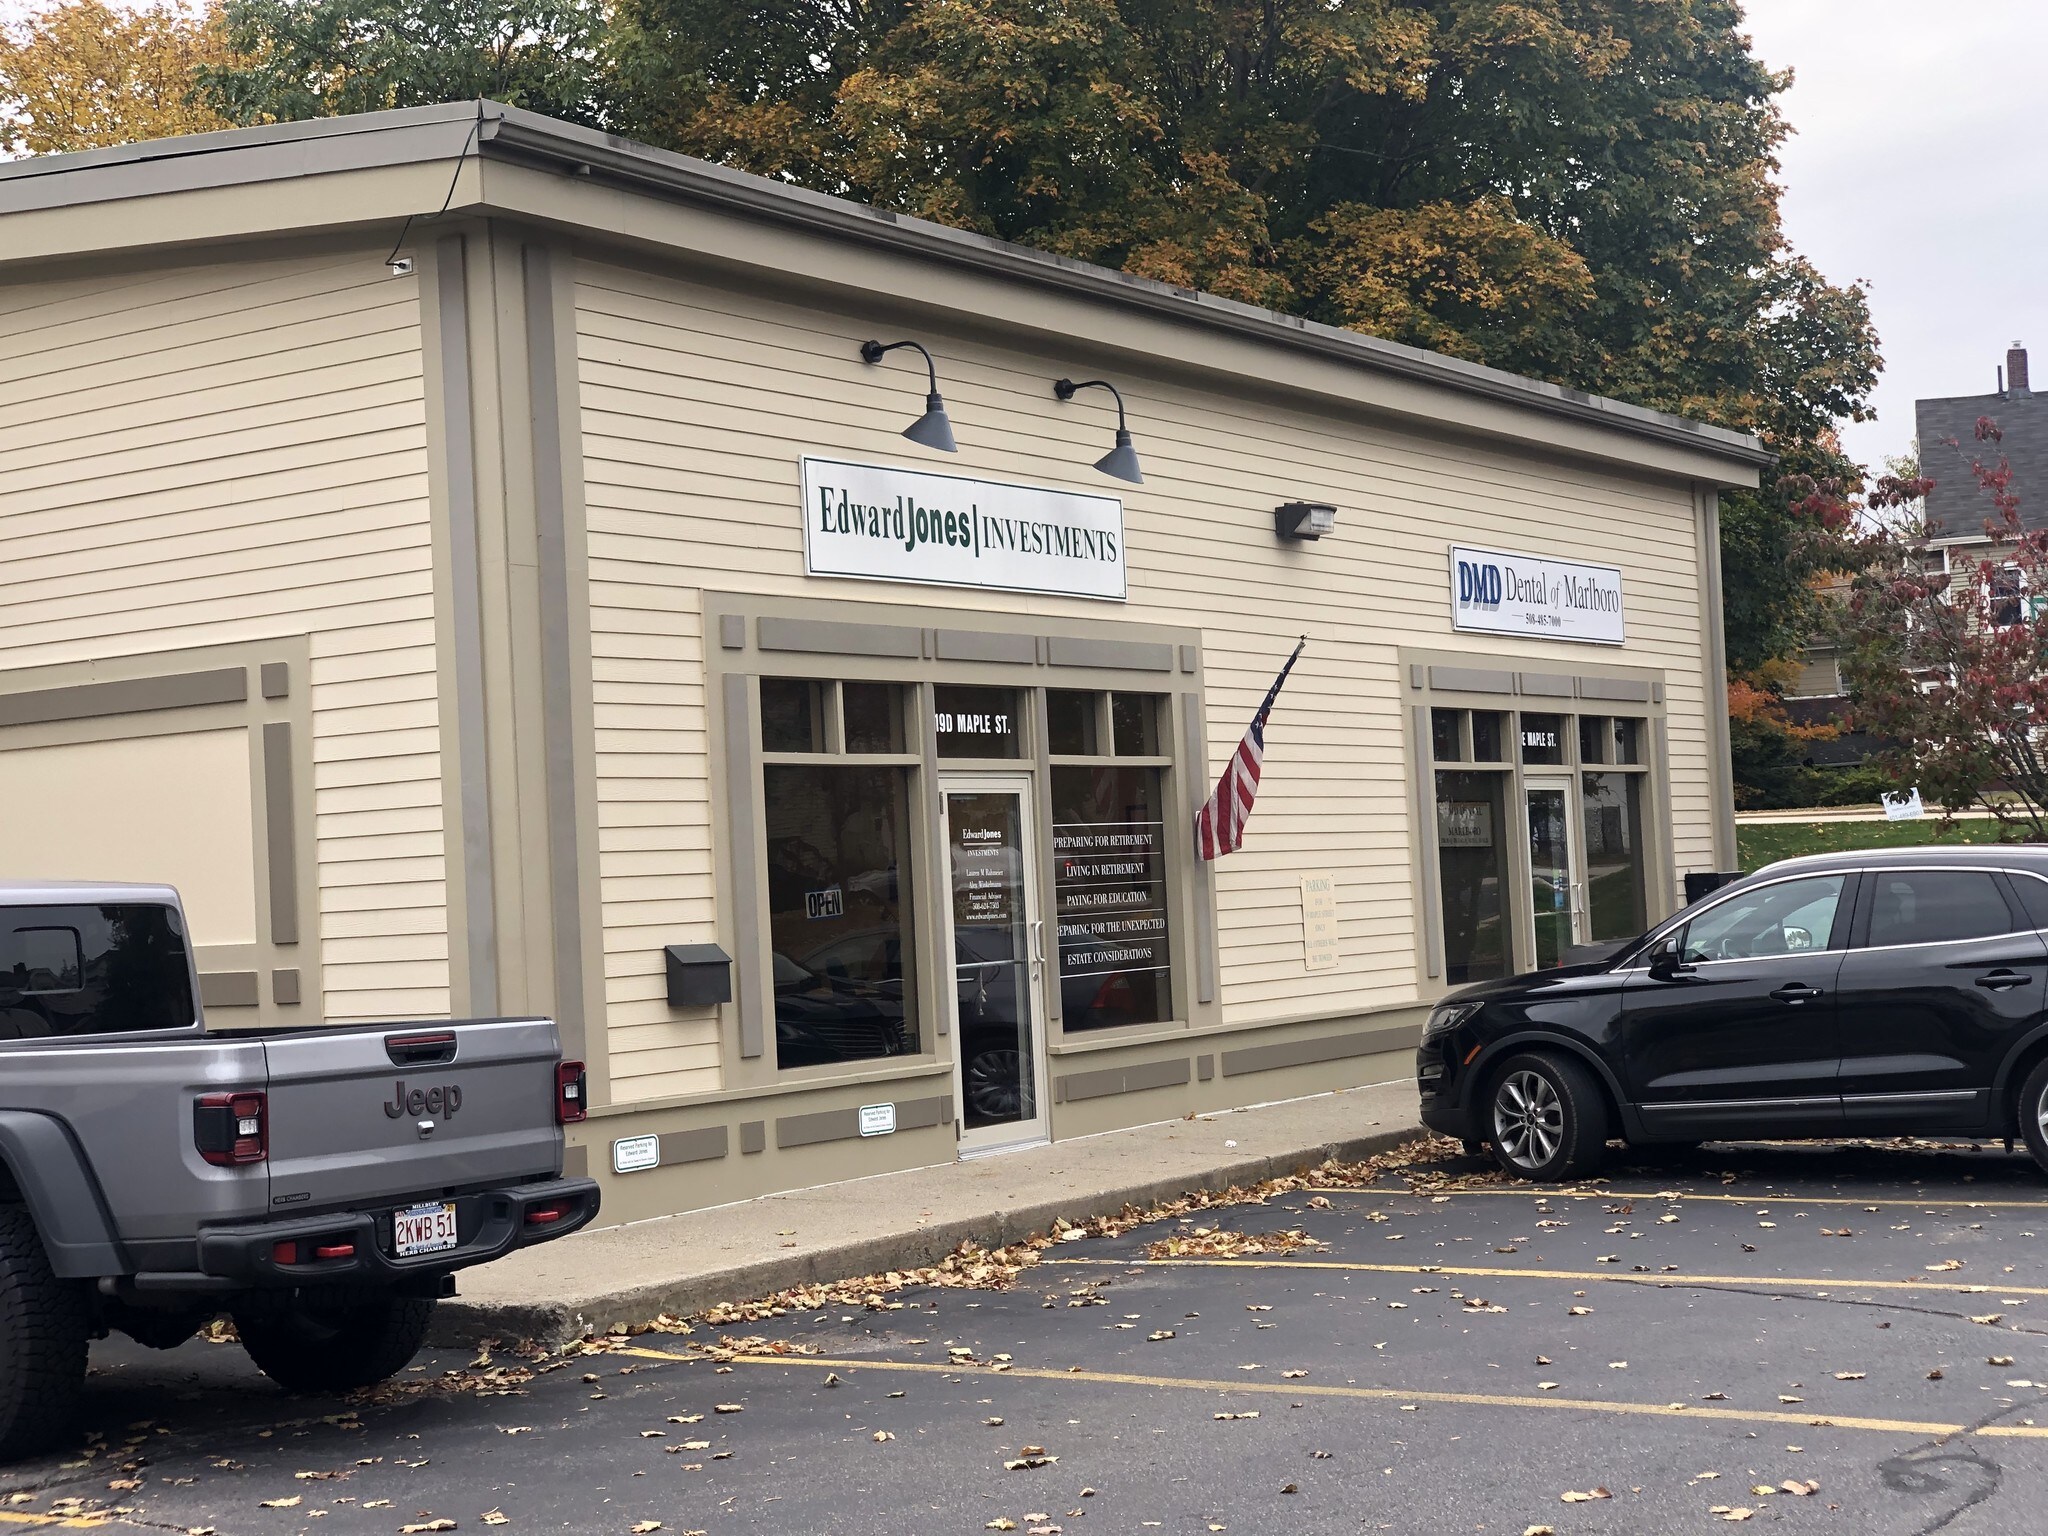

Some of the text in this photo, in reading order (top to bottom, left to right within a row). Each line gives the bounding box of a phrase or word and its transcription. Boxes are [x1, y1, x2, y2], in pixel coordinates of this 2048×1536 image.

[982, 515, 1118, 563] INVESTMENTS
[1458, 561, 1620, 613] DMD Dental of Marlboro
[1525, 612, 1562, 628] 508-485-7000
[935, 712, 1011, 735] 19D MAPLE ST.
[1527, 731, 1547, 747] MAPLE
[1547, 732, 1557, 747] ST.
[1054, 834, 1153, 848] PREPARING FOR RETIREMENT
[967, 849, 999, 857] INVESTMENTS
[1066, 862, 1145, 877] LIVING IN RETIREMENT
[1305, 879, 1330, 892] PARKING
[808, 890, 841, 917] OPEN
[969, 892, 987, 900] Financial
[1066, 891, 1147, 907] PAYING FOR EDUCATION
[1091, 922, 1106, 934] FOR
[1106, 921, 1121, 933] THE
[1121, 918, 1166, 932] UNEXPECTED
[1067, 947, 1152, 966] ESTATE CONSIDERATIONS
[384, 1080, 463, 1121] Jeep
[396, 1213, 456, 1246] 2KWB 51
[418, 1243, 456, 1254] CHAMBERS
